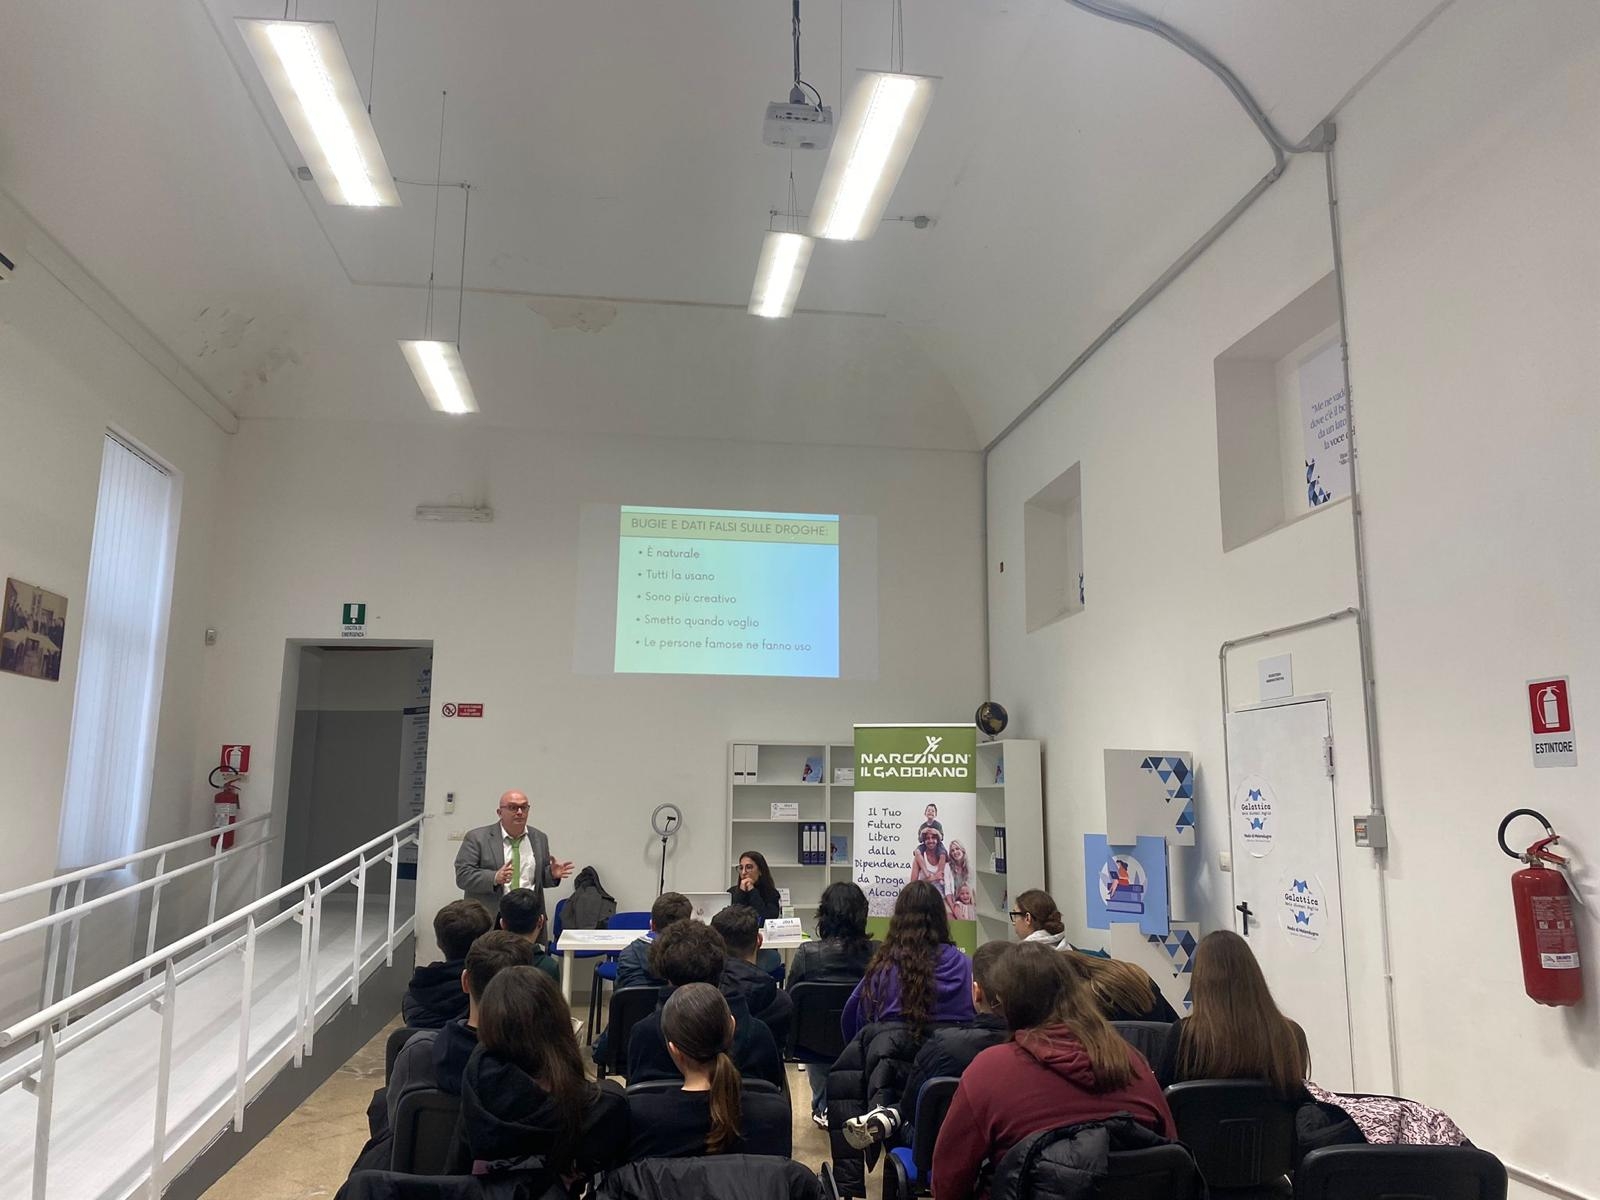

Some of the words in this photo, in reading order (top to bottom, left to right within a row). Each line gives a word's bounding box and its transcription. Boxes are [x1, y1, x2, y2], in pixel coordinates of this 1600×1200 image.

[631, 518, 667, 530] BUGIE
[671, 519, 677, 530] E
[681, 520, 706, 531] DATI
[709, 521, 737, 532] FALSI
[740, 522, 771, 534] SULLE
[775, 523, 828, 536] DROGHE:
[656, 547, 700, 559] naturale
[646, 569, 668, 580] Tutti
[671, 569, 681, 580] la
[684, 572, 715, 581] usano
[645, 592, 671, 602] Sono
[675, 592, 690, 605] più
[693, 593, 737, 604] creativo
[645, 614, 681, 625] Smetto
[684, 616, 724, 628] quando
[727, 616, 760, 630] voglio
[644, 637, 656, 648] Le
[659, 639, 702, 651] persone
[705, 637, 743, 649] famose
[746, 641, 758, 650] ne
[762, 639, 791, 651] fanno
[795, 642, 812, 651] uso
[1535, 741, 1573, 754] ESTINTORE
[860, 766, 871, 777] IL
[873, 766, 968, 778] GABBIANO
[868, 808, 877, 816] Il
[882, 808, 902, 817] Tuo
[1241, 803, 1271, 811] Galattica
[867, 820, 902, 829] Futuro
[868, 832, 900, 842] Libero
[868, 846, 896, 856] dalla
[855, 859, 912, 872] Dipendenza
[857, 874, 869, 883] da
[875, 875, 905, 887] Droga
[1284, 893, 1319, 906] Galattica
